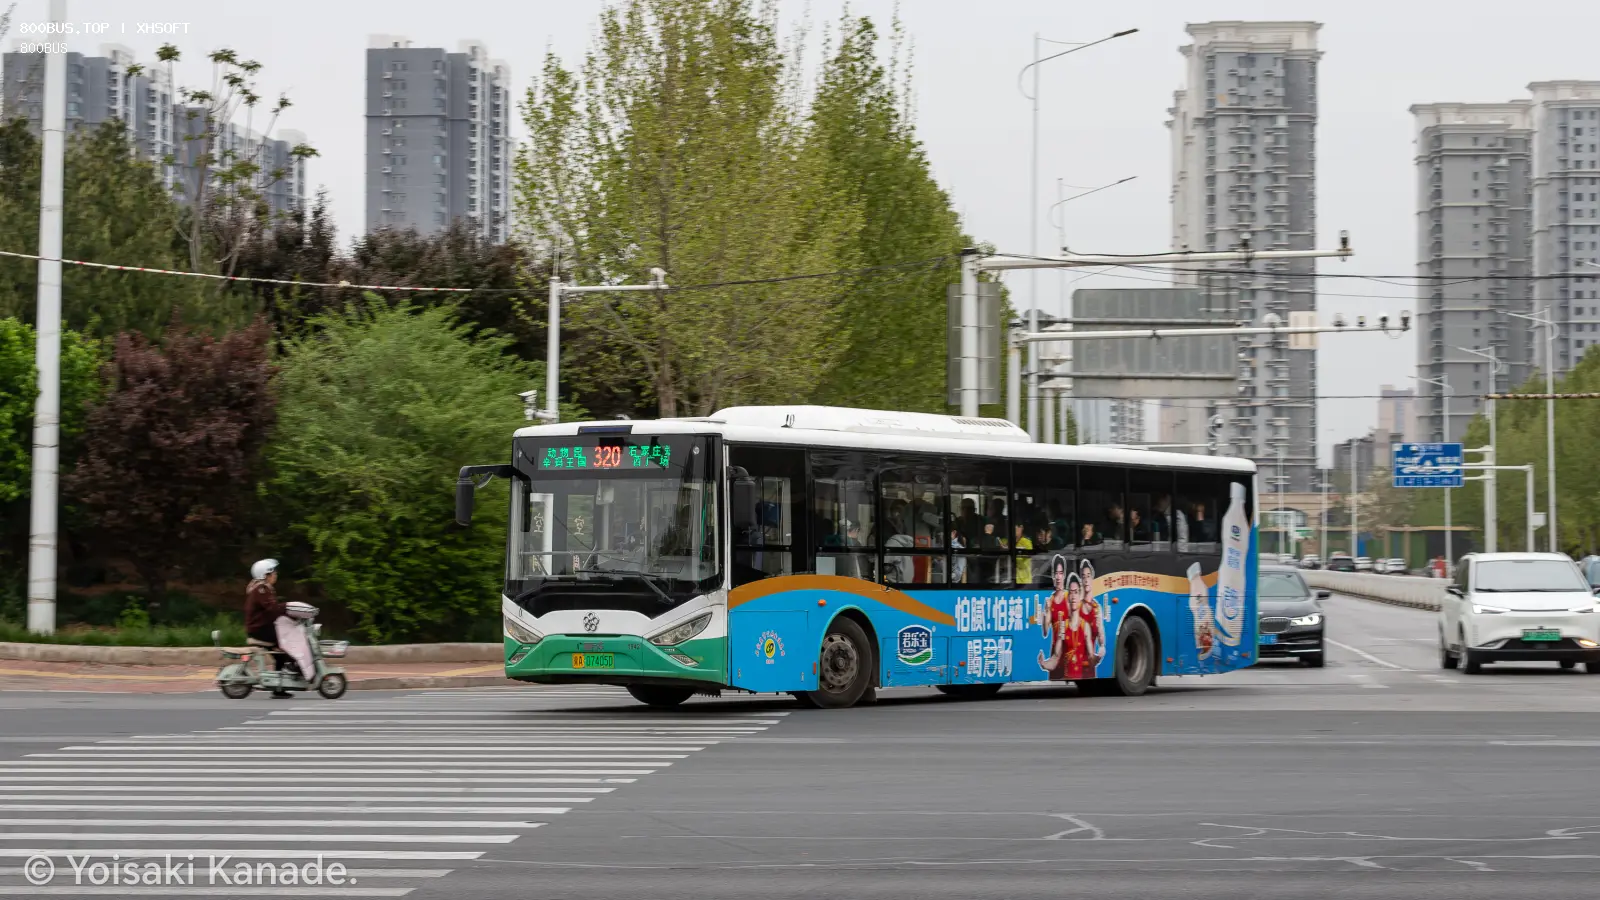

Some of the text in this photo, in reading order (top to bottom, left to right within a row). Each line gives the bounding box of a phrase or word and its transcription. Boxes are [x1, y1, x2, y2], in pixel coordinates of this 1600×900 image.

[547, 446, 583, 458] 动物园
[593, 446, 621, 468] 320
[632, 456, 669, 467] 西广场
[902, 631, 928, 648] 君乐宝
